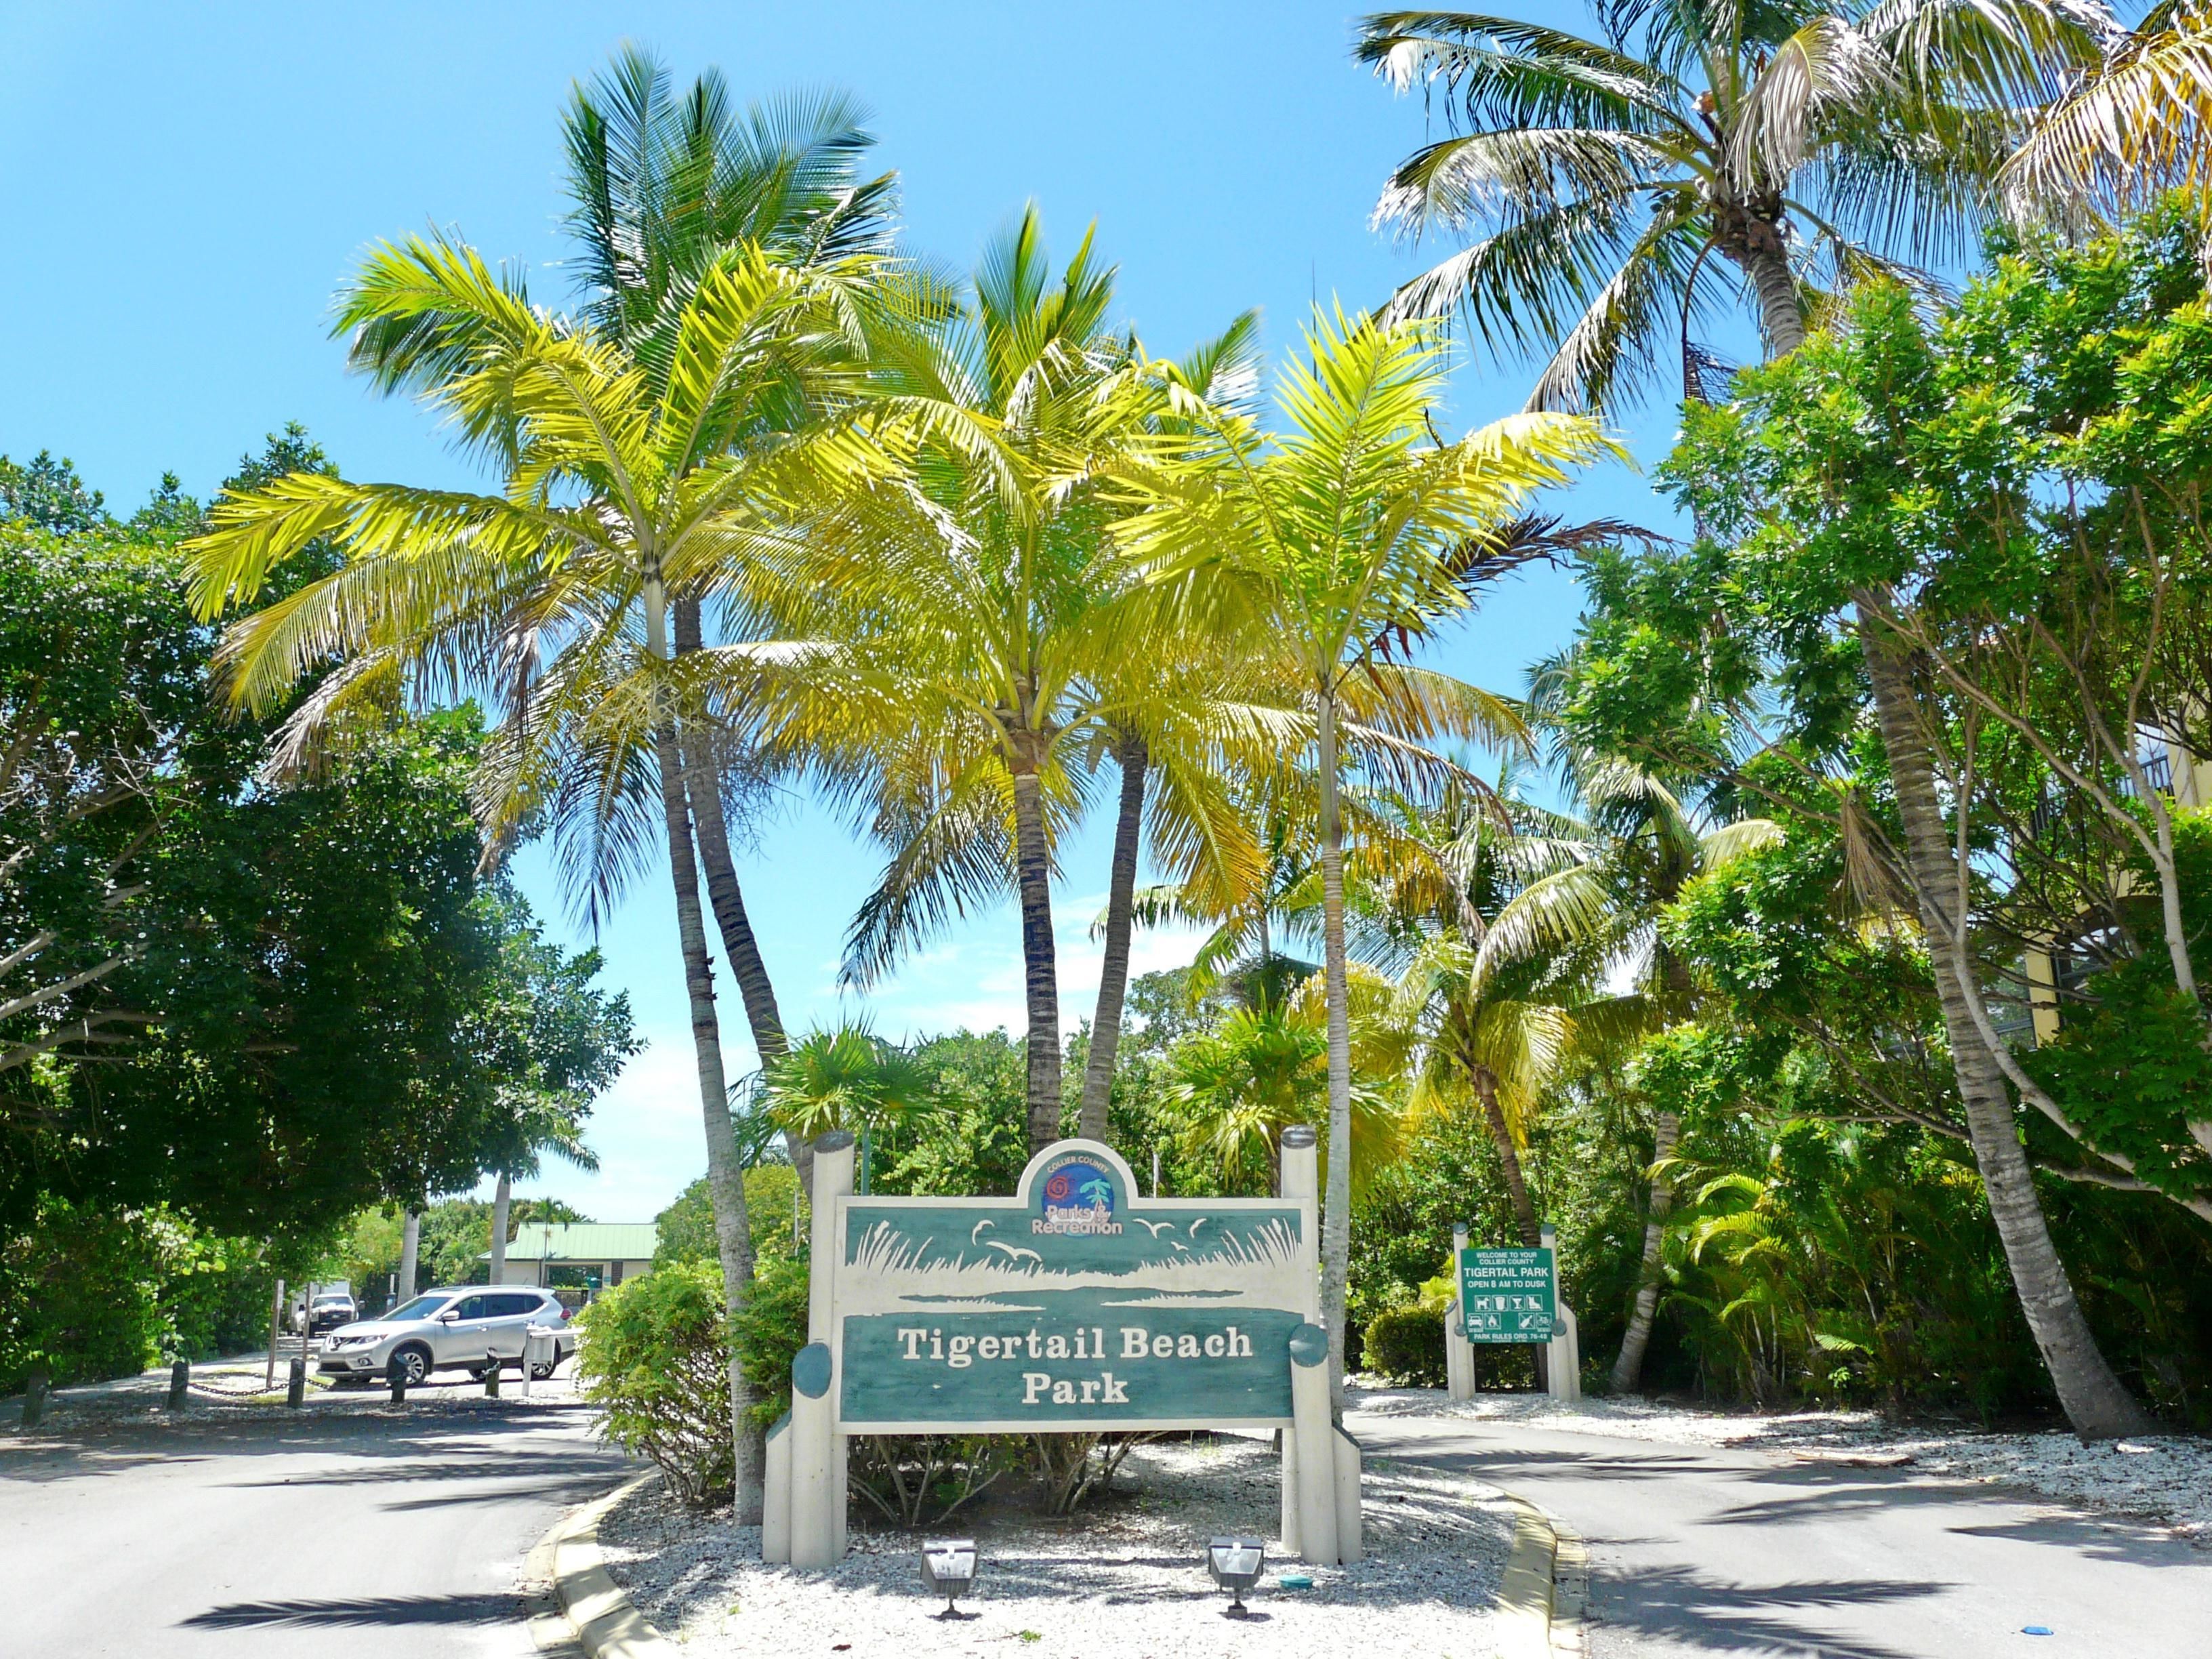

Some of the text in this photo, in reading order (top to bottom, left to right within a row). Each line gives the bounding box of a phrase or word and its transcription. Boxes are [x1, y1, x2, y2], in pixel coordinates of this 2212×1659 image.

[1047, 1155, 1109, 1173] COLLIER COUNTY
[1047, 1204, 1109, 1219] Parks &
[1031, 1219, 1123, 1234] Recreation
[1464, 1267, 1549, 1277] TIGERTAIL PARK
[897, 1327, 1253, 1368] Tigertail Beach
[1021, 1372, 1130, 1404] Park
